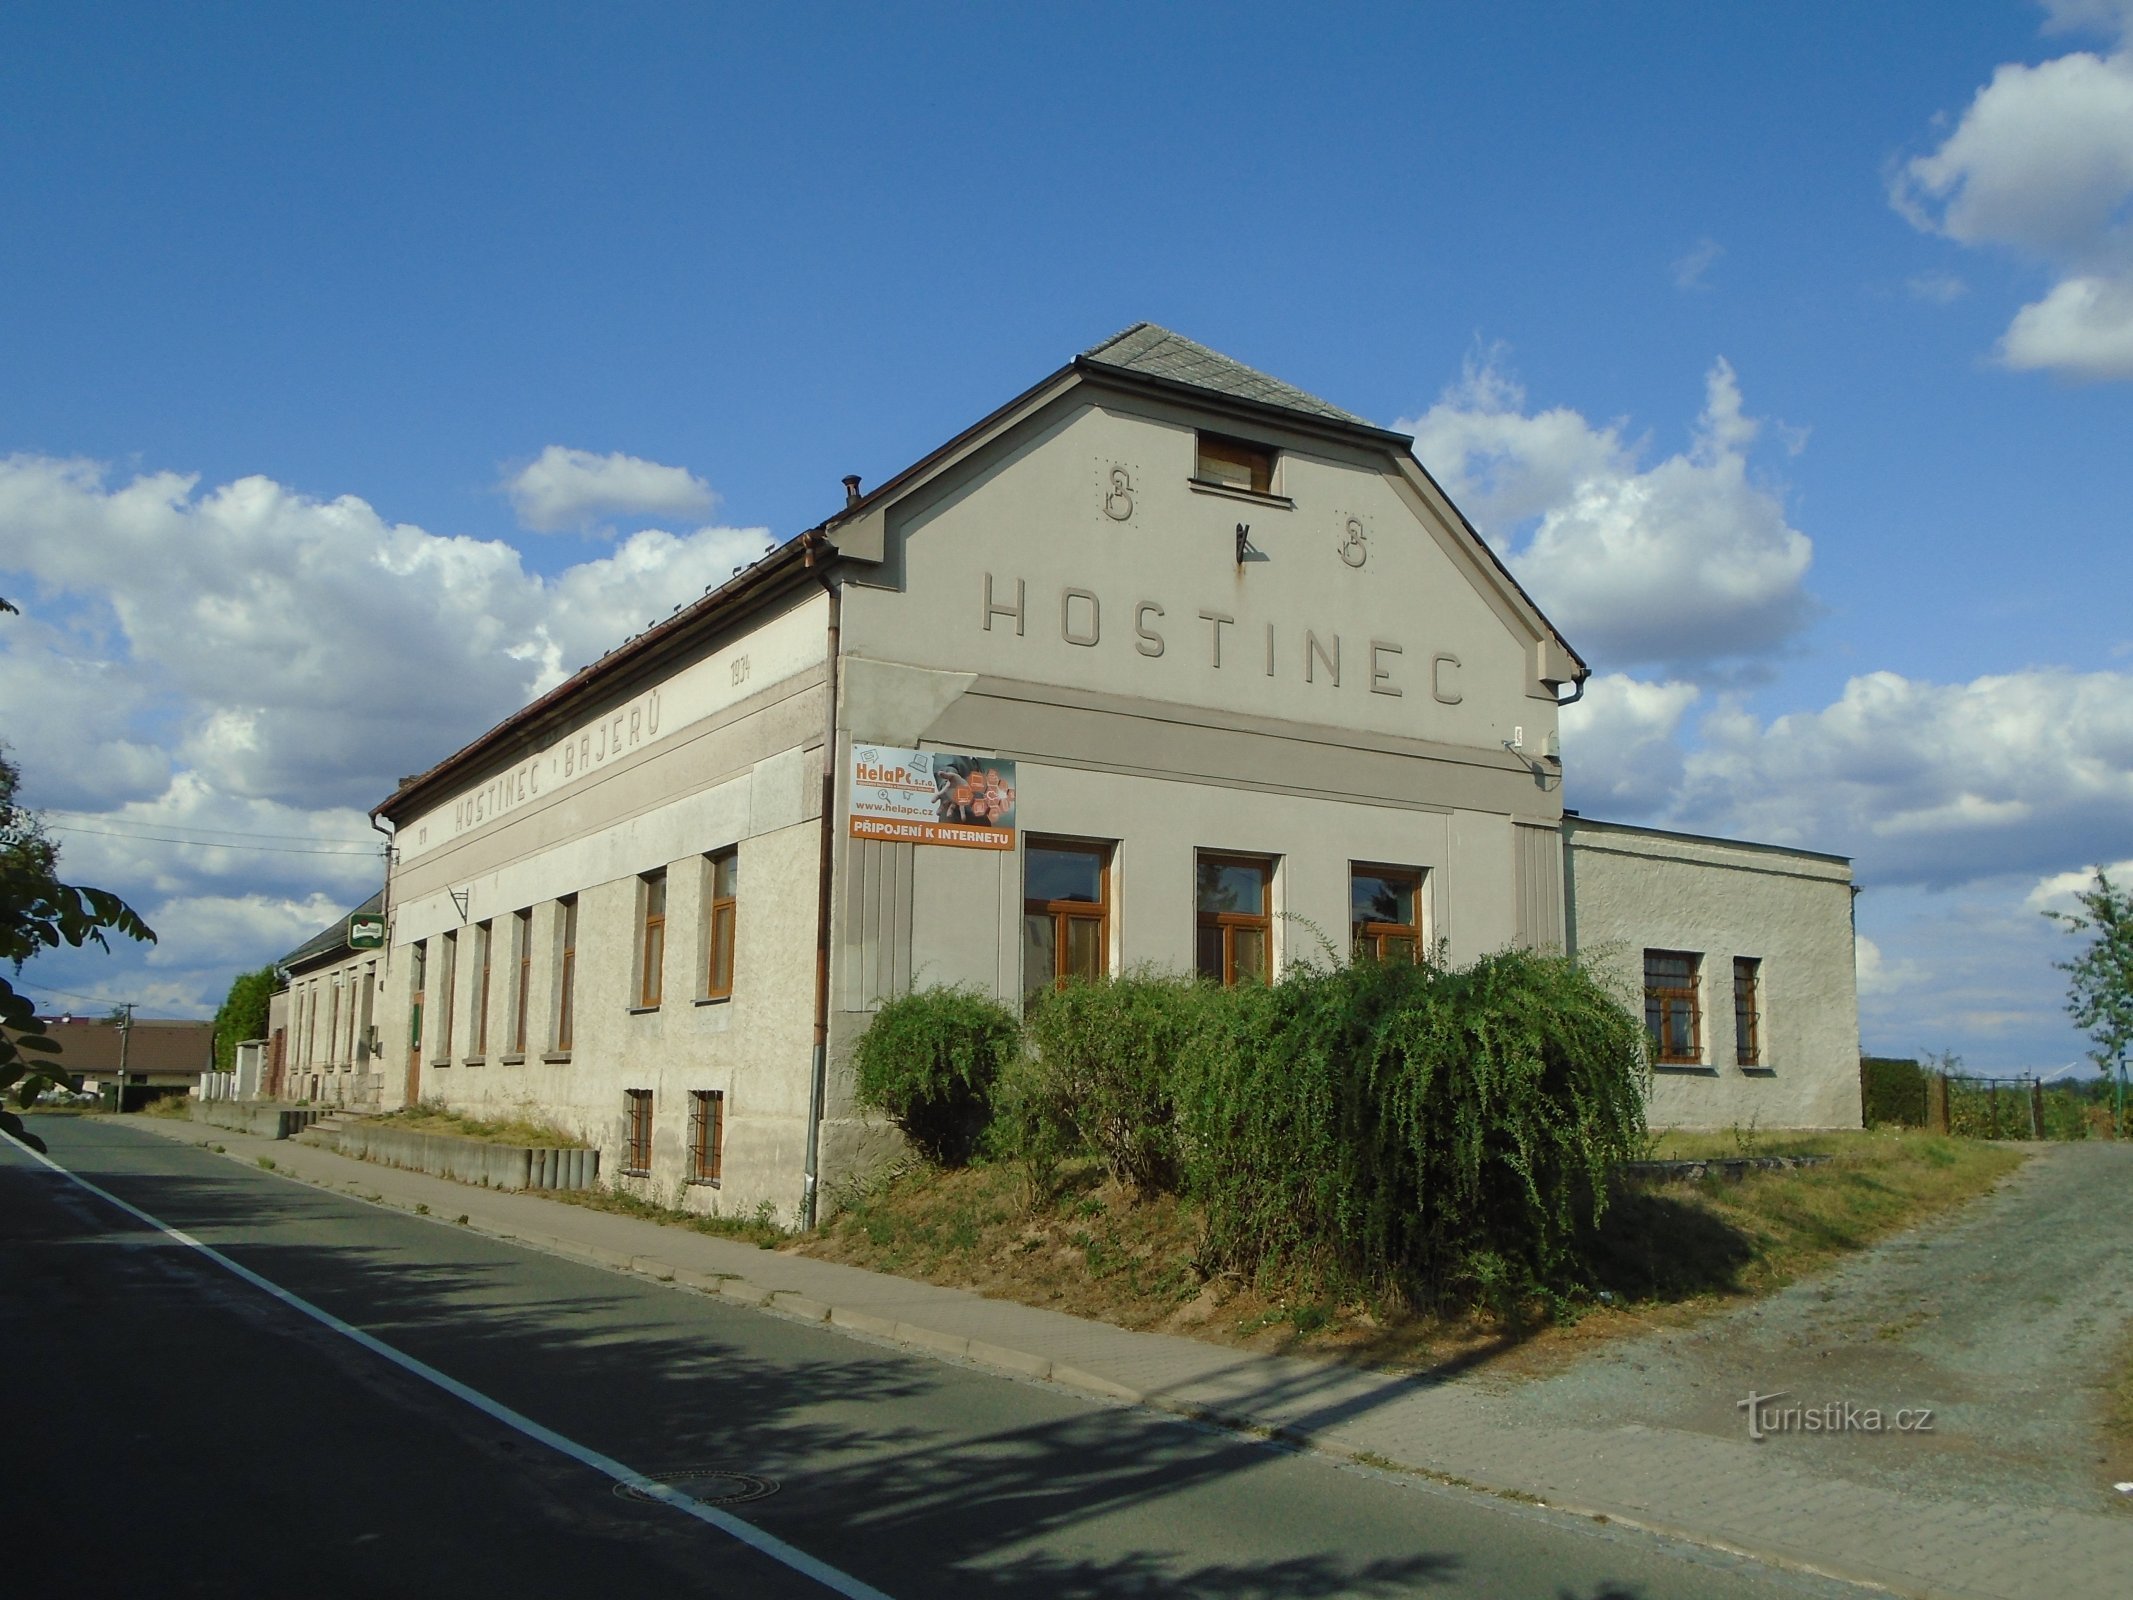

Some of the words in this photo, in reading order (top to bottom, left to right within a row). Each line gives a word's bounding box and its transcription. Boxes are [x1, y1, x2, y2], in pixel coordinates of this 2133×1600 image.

[982, 572, 1463, 706] HOSTINEC
[730, 654, 750, 688] 1934
[856, 762, 912, 785] HelaPc
[914, 778, 935, 787] s.r.o.
[455, 760, 539, 833] HOSTINEC
[855, 801, 934, 817] www.helapc.cz
[853, 819, 922, 838] PŘIPOJENÍ
[925, 827, 935, 839] K
[937, 828, 1009, 845] INTERNETU
